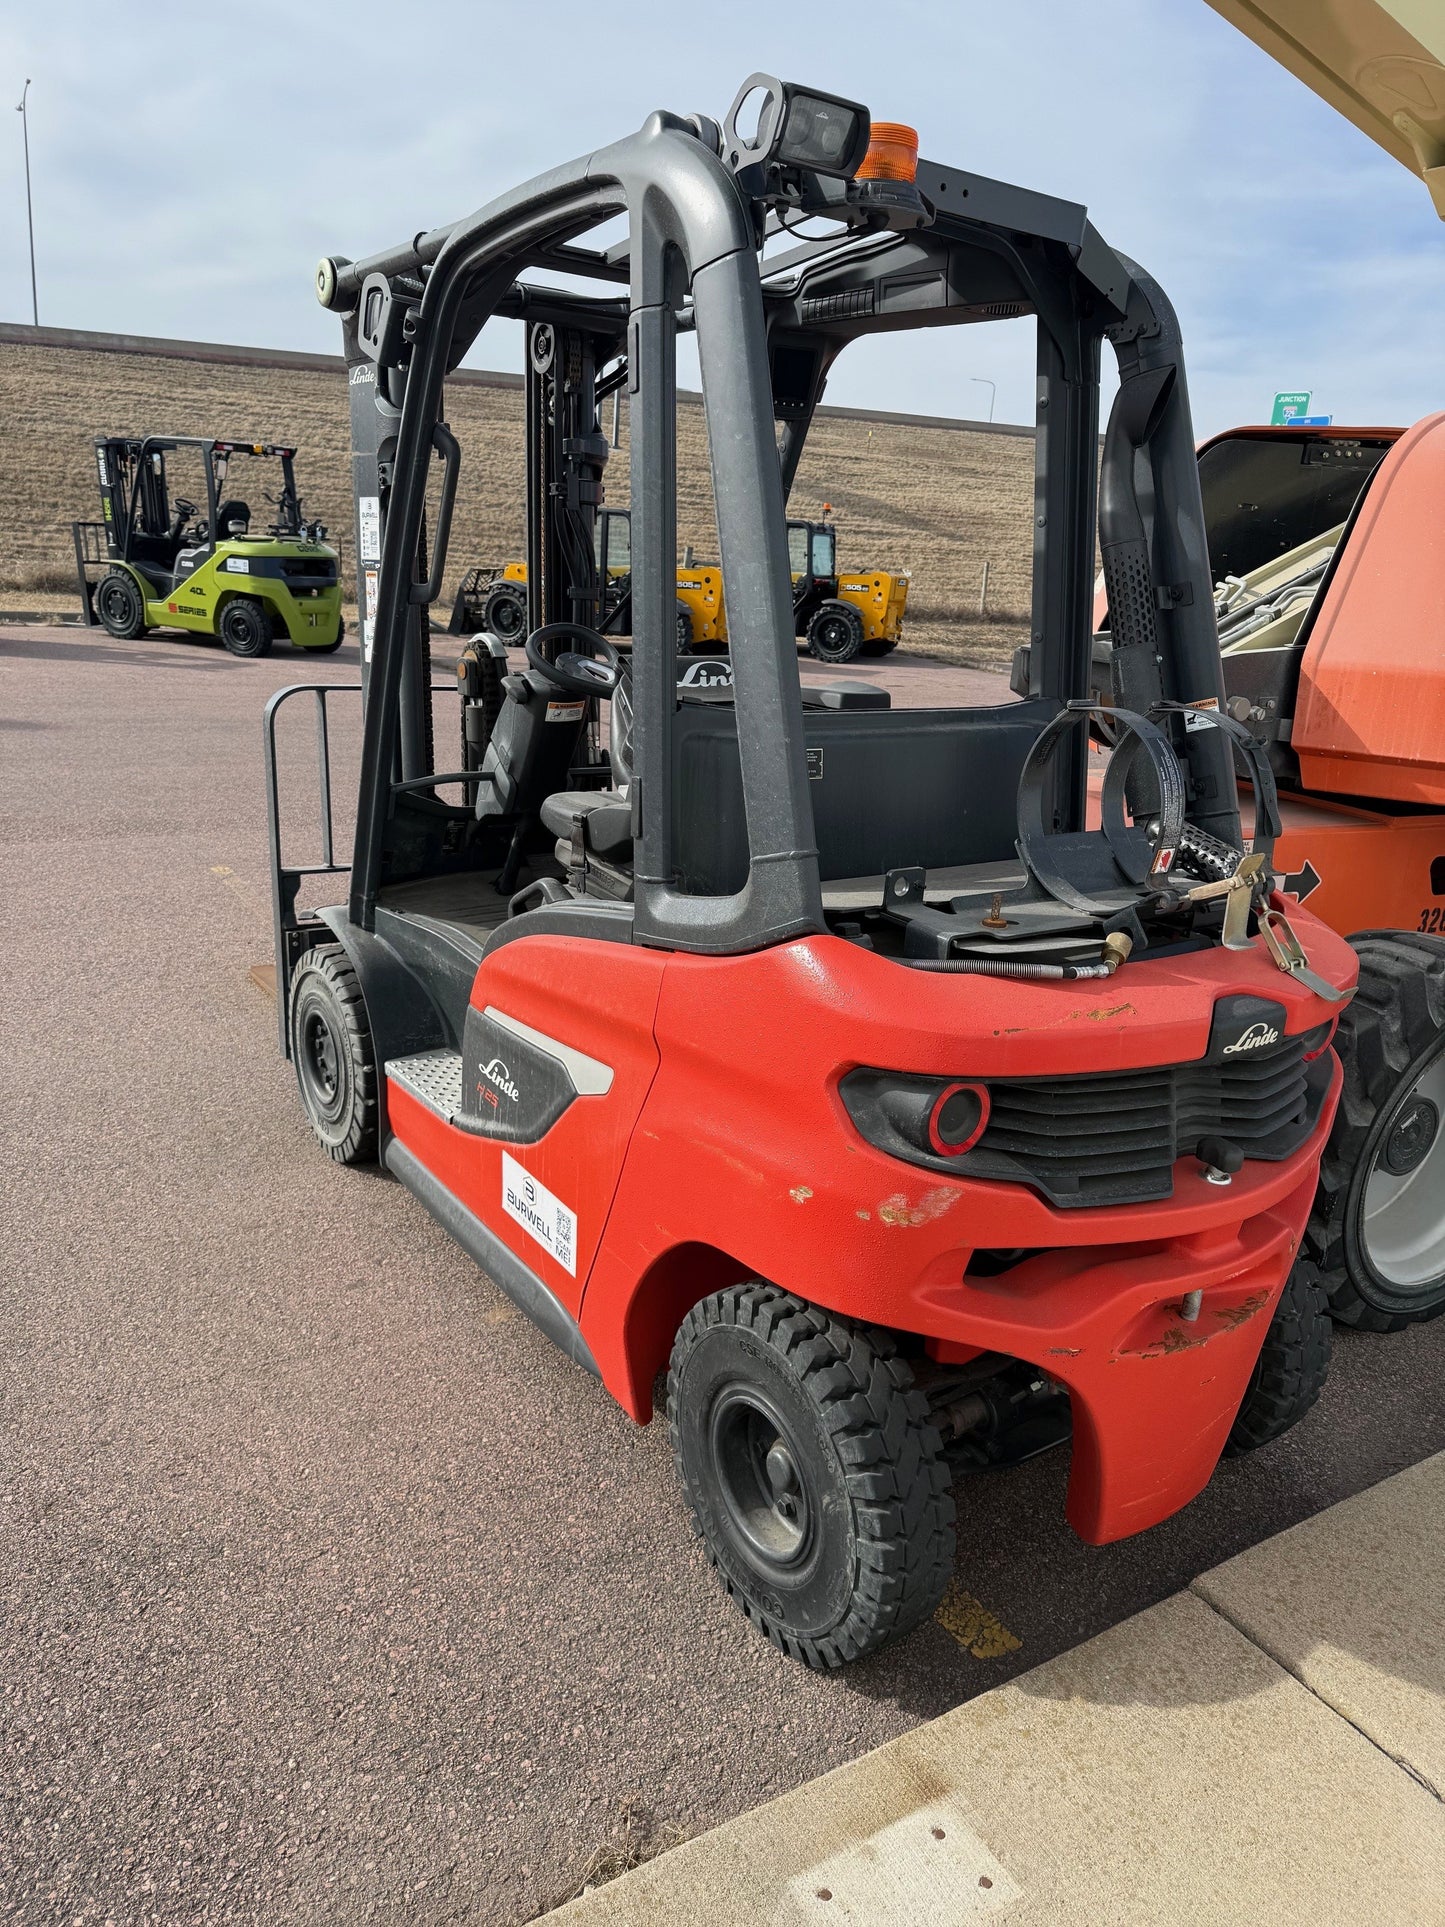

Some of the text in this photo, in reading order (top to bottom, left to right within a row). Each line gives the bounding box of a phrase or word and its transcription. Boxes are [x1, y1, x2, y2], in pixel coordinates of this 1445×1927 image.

[350, 365, 375, 386] Linde
[1278, 395, 1307, 403] JUNCTION
[178, 605, 207, 617] SERIES
[676, 661, 735, 688] Lin
[1222, 1022, 1279, 1054] Linde
[479, 1059, 519, 1102] Linde
[507, 1187, 553, 1243] BURWELL
[555, 1244, 571, 1267] ME!
